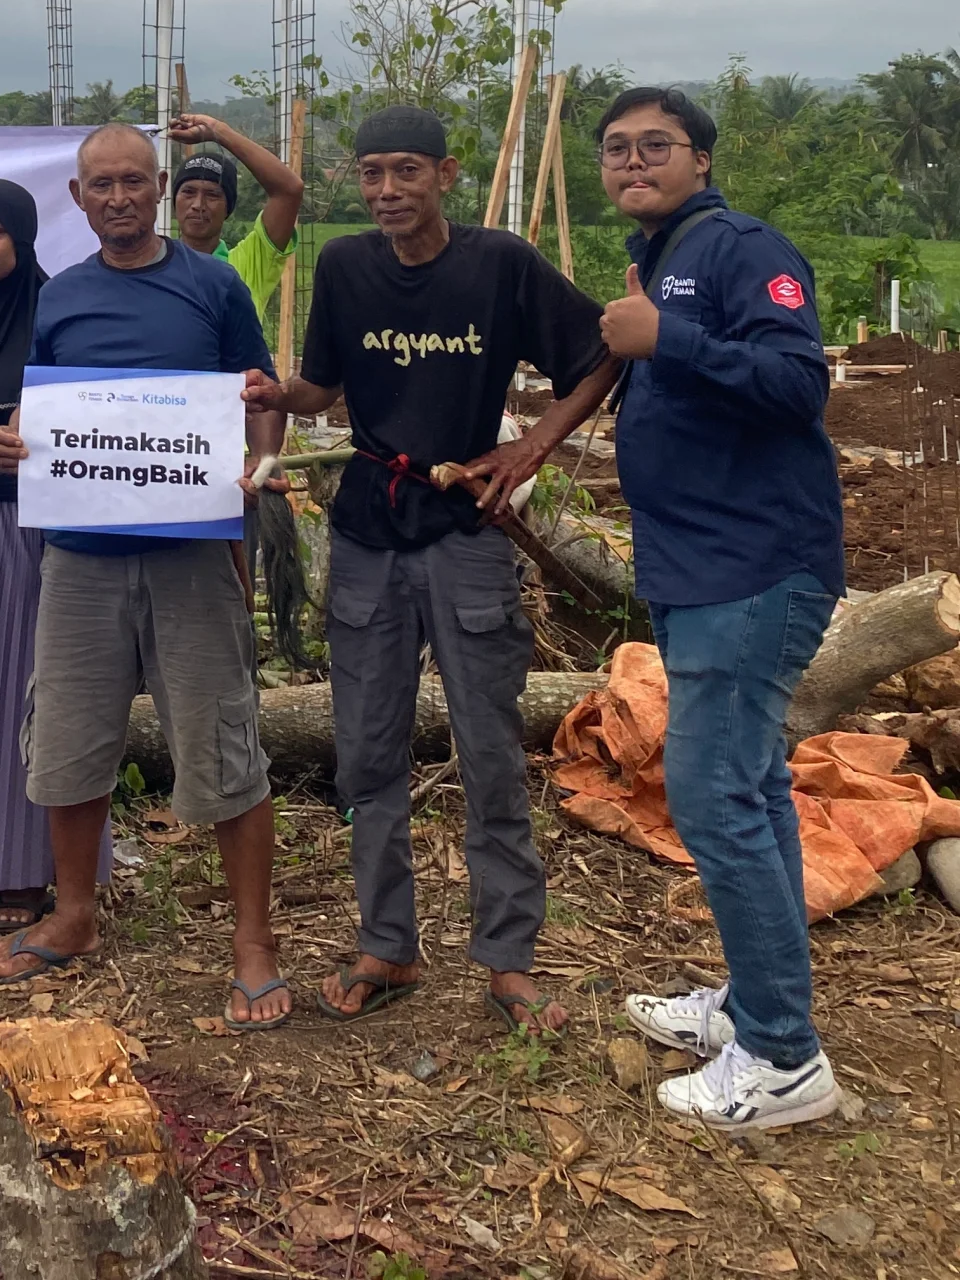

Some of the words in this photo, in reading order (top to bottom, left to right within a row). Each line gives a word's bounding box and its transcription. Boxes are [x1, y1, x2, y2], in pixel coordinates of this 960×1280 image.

[672, 287, 695, 296] TEMAN
[674, 278, 696, 287] BANTU
[362, 323, 483, 367] argyant
[142, 393, 187, 406] Kitabisa
[50, 427, 211, 455] Terimakasih
[50, 458, 209, 486] #OrangBaik
